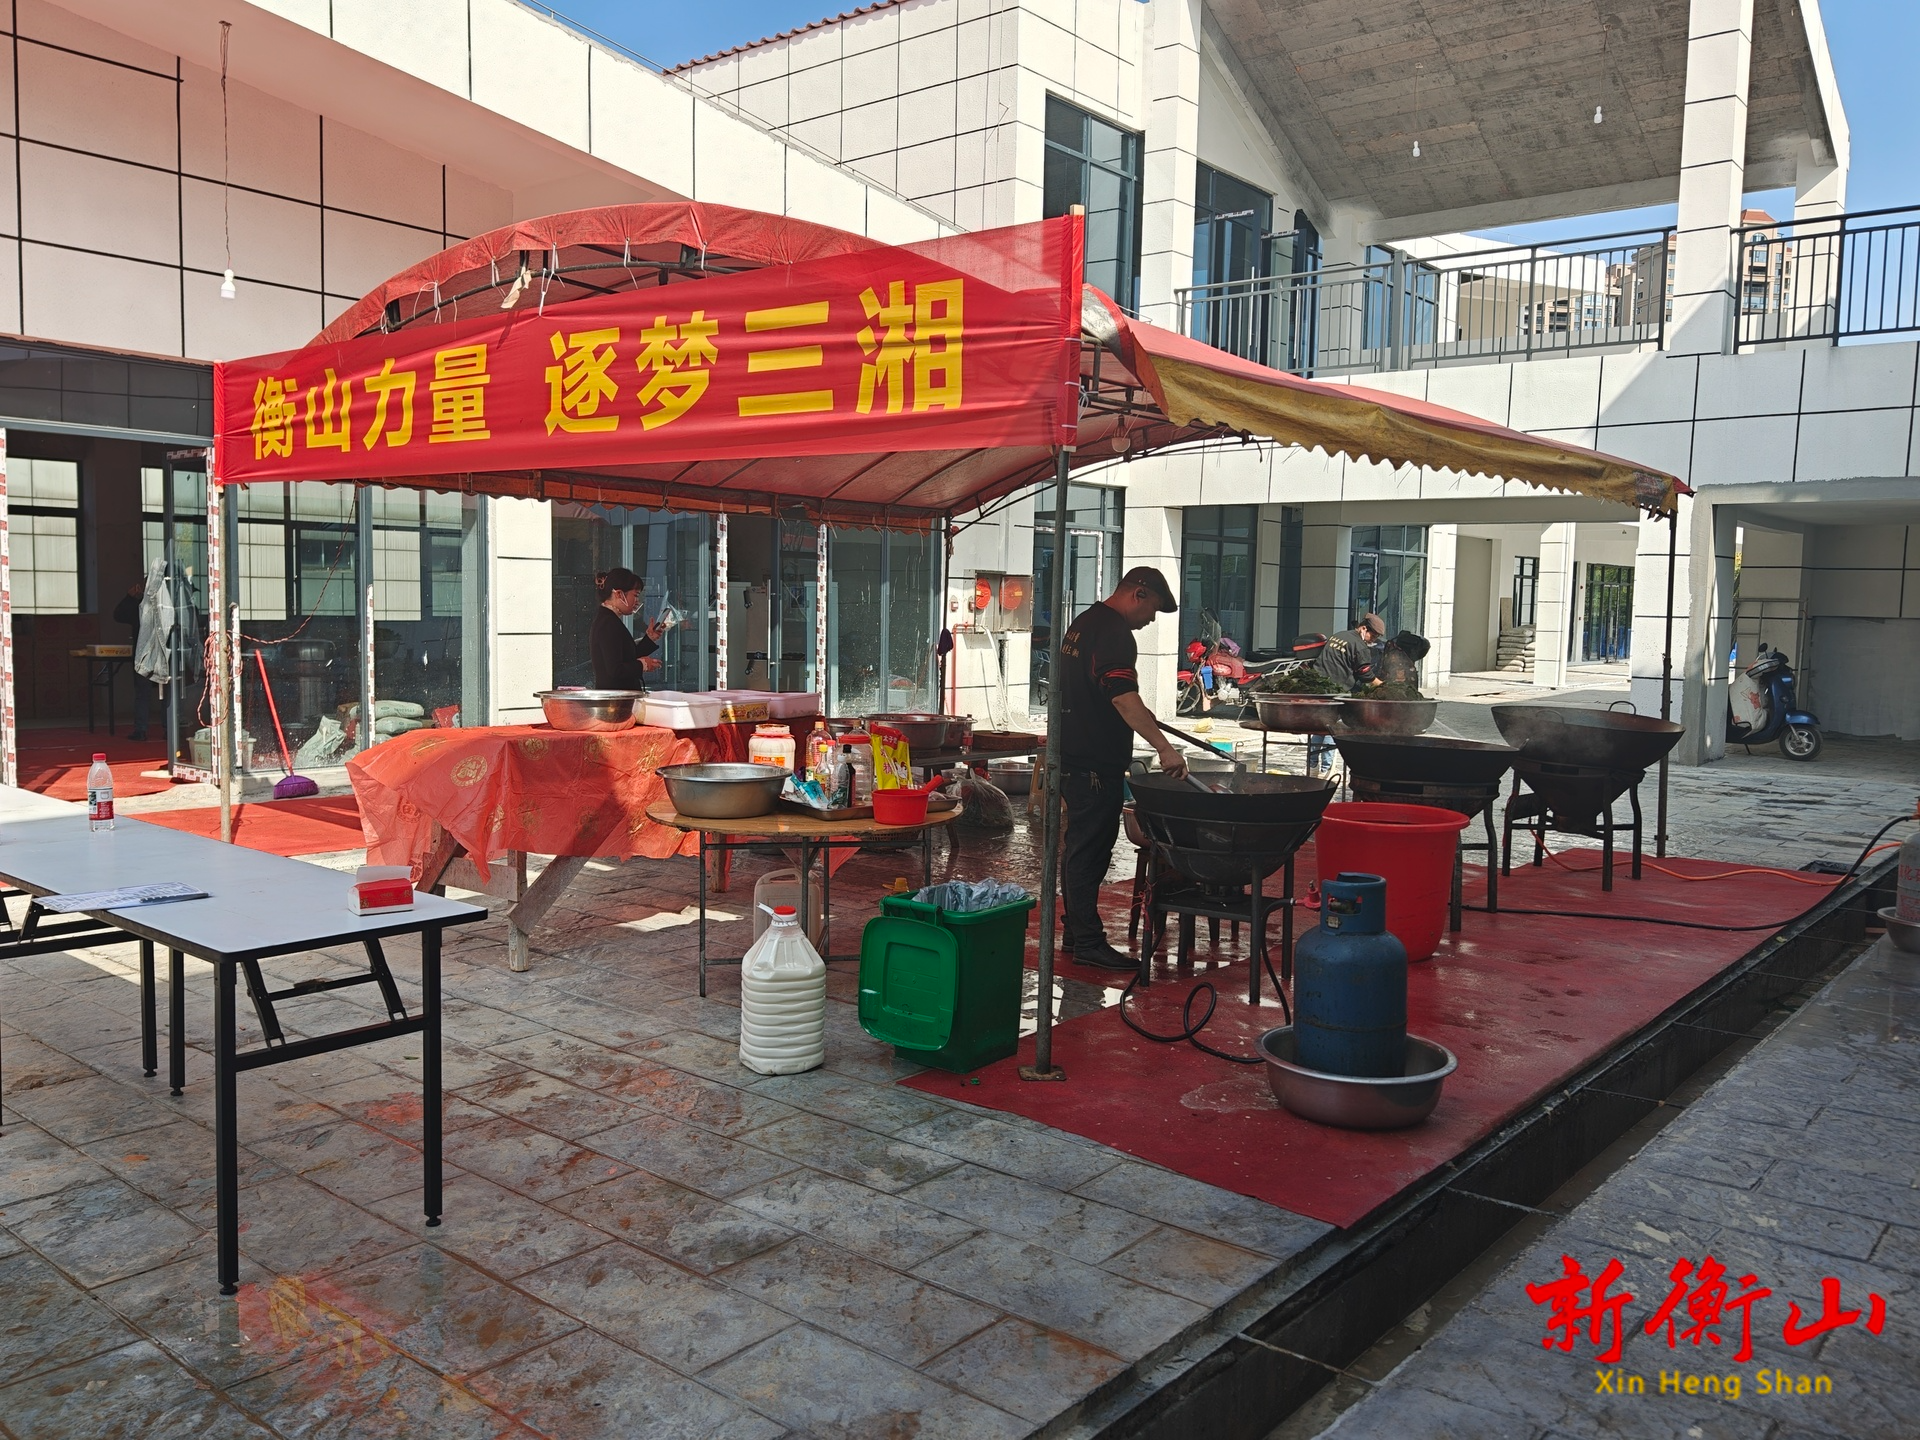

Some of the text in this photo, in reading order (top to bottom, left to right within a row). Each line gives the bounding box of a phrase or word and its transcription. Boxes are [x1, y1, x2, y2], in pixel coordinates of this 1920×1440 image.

[251, 279, 964, 460] 衡山力量 逐梦三湘
